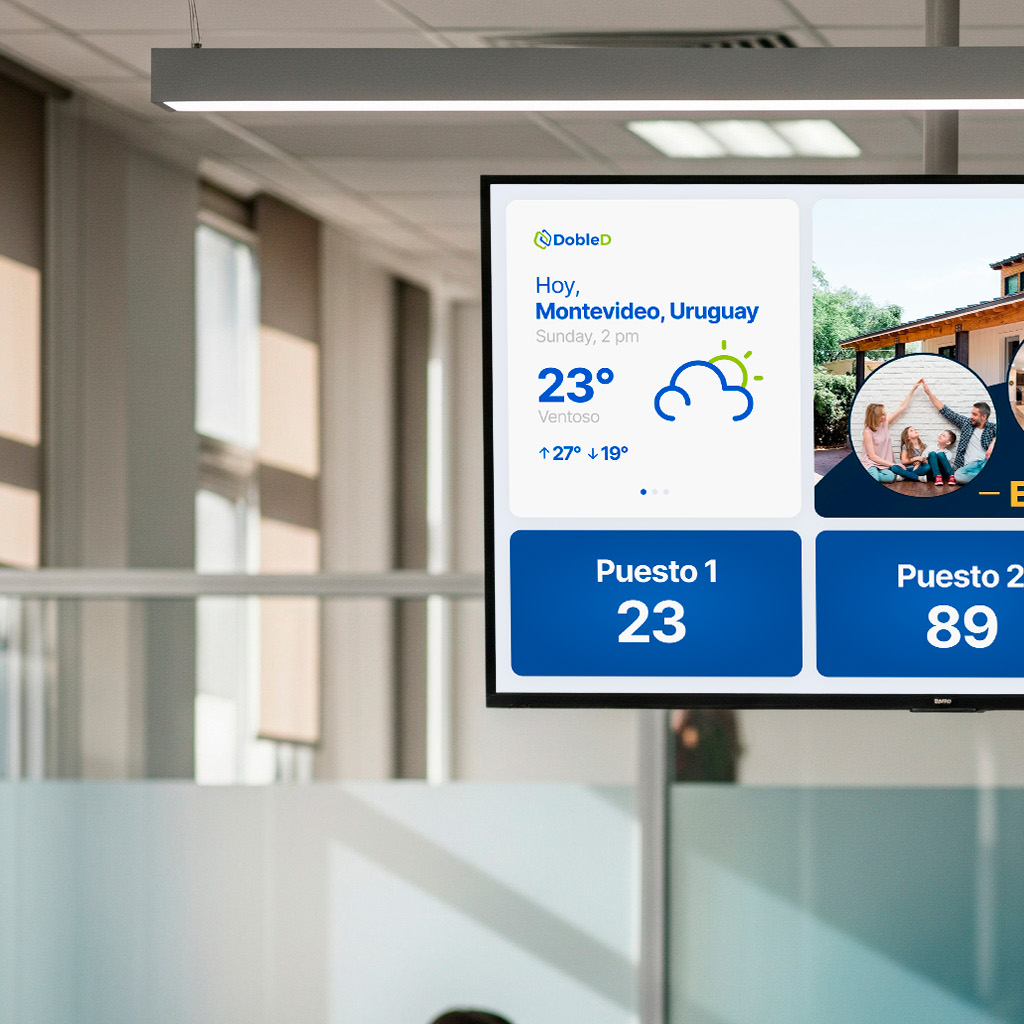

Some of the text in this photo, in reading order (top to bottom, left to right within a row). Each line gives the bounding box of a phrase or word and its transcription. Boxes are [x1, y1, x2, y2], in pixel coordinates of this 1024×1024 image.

[554, 233, 611, 245] DobleD
[537, 277, 579, 298] Hoy,
[536, 302, 759, 323] Montevideo, Uruguay
[537, 329, 639, 345] Sunday, 2 pm
[538, 368, 614, 403] 23°
[538, 410, 599, 423] Ventoso
[553, 446, 628, 460] 27° 19°
[597, 559, 716, 583] Puesto 1
[898, 564, 1024, 588] Puesto 2
[618, 600, 686, 643] 23
[927, 605, 997, 648] 89
